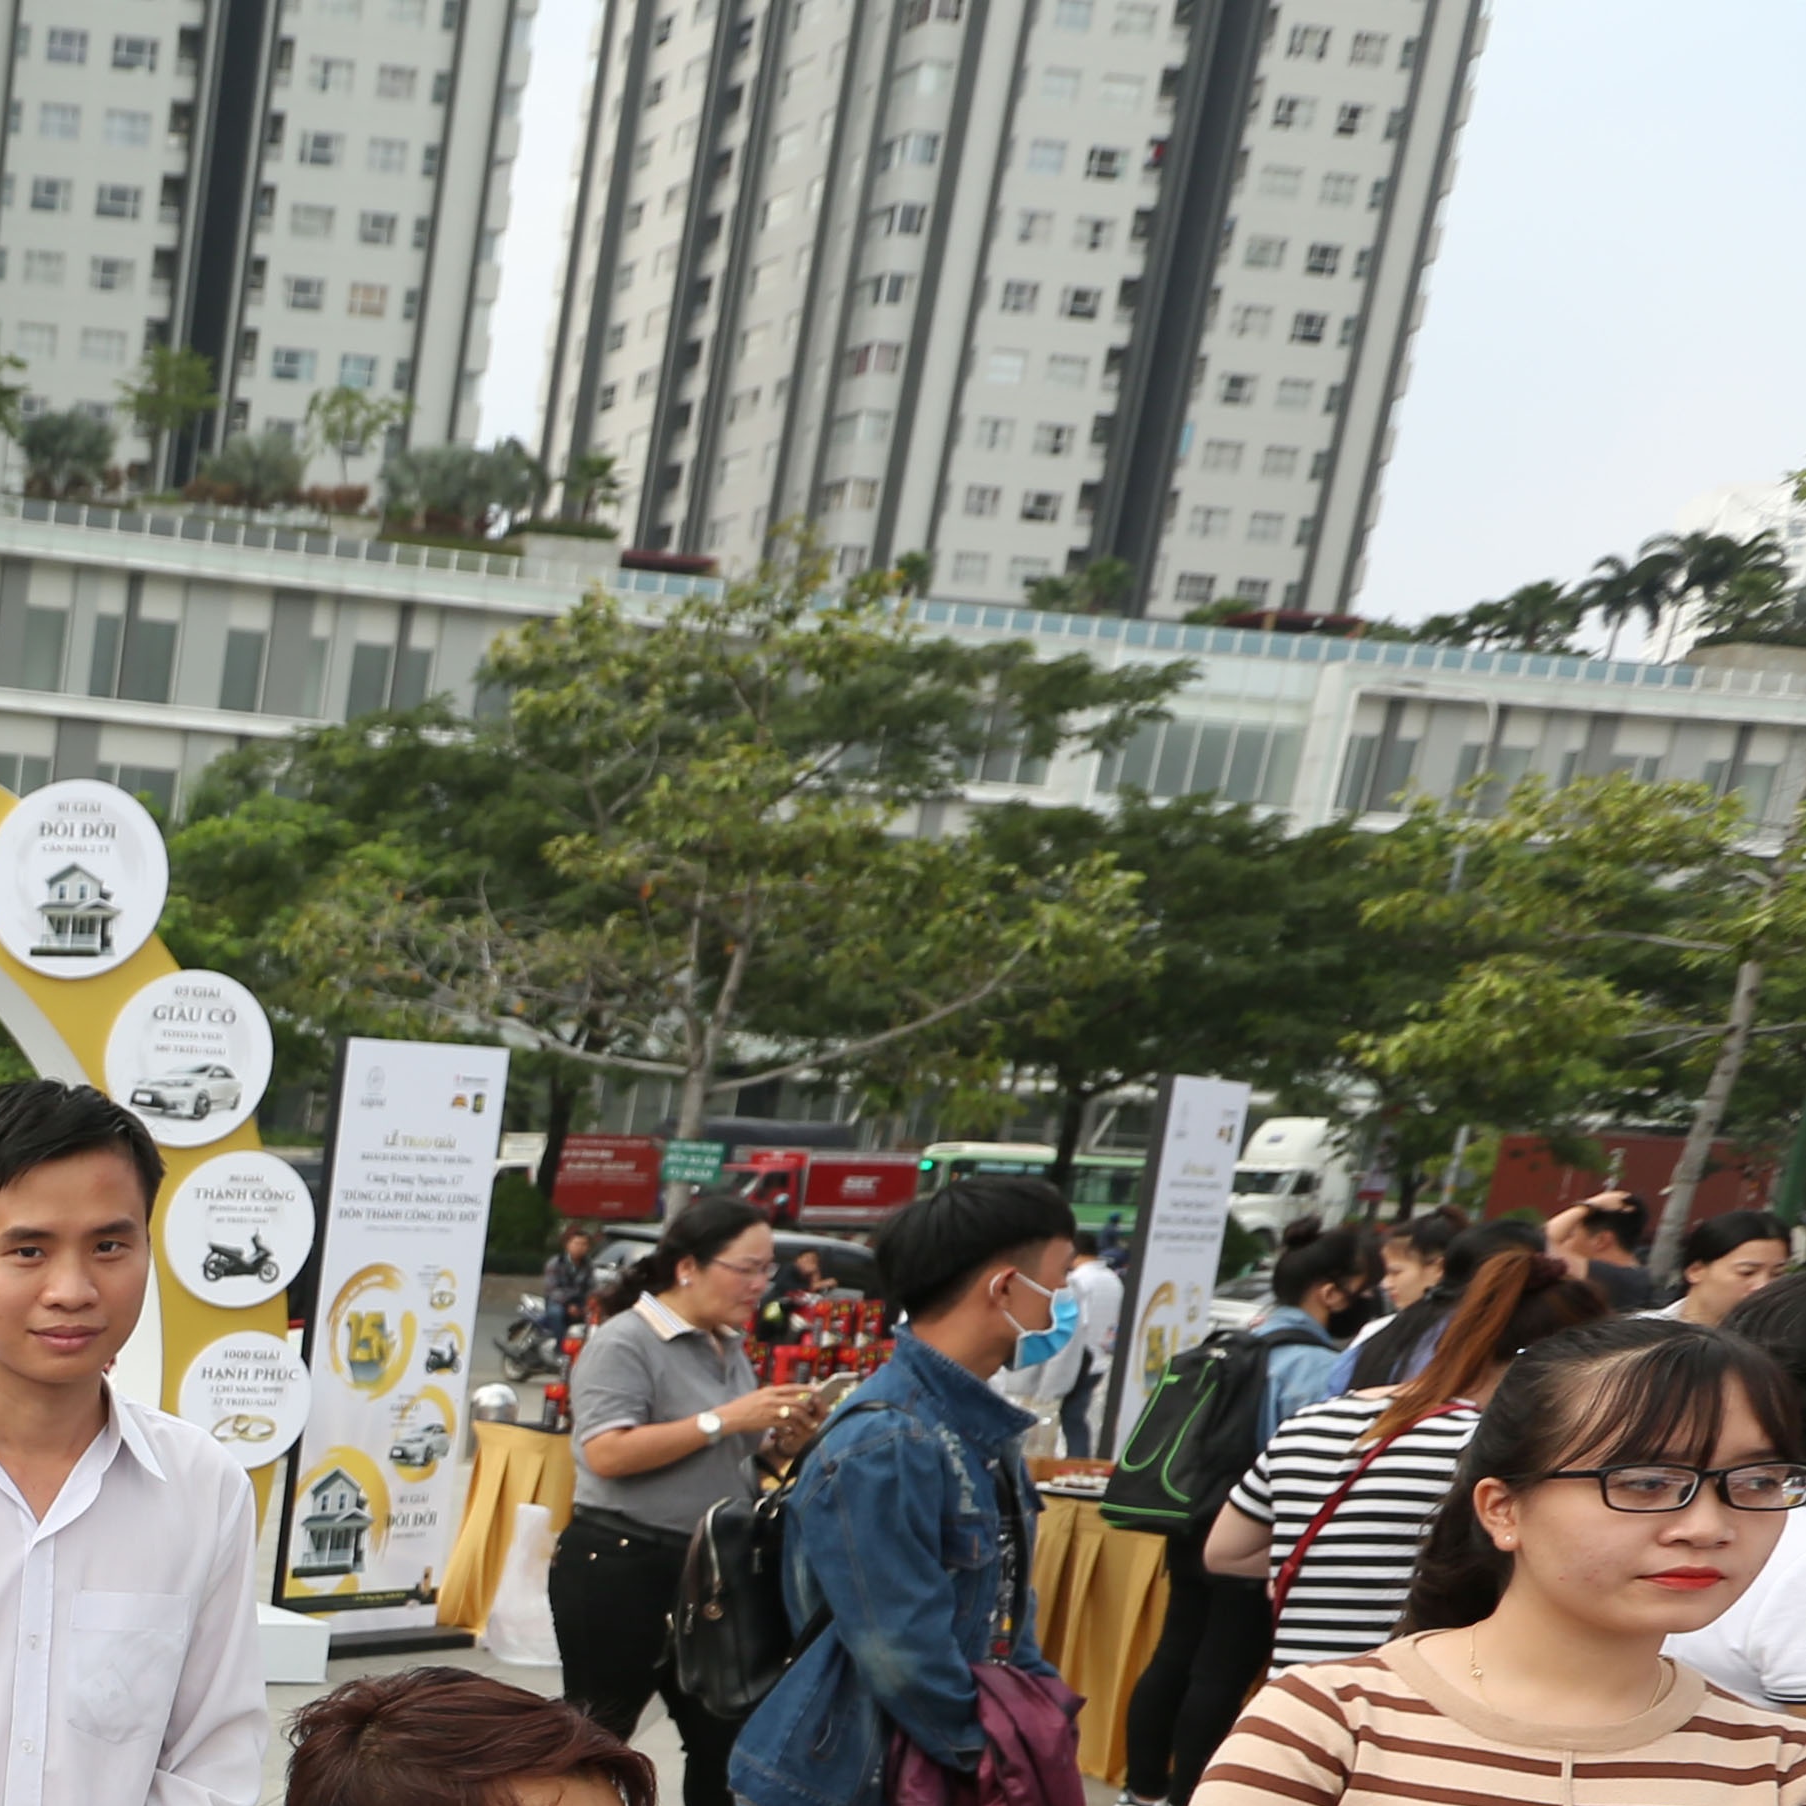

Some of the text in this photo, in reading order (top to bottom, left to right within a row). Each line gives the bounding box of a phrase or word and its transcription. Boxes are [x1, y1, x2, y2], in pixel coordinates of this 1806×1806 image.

[152, 1001, 237, 1026] GIÀU CÓ
[193, 1187, 296, 1202] THÀNH CÔNG
[223, 1349, 252, 1361] 1000
[200, 1365, 300, 1383] HẠNH PHÚC
